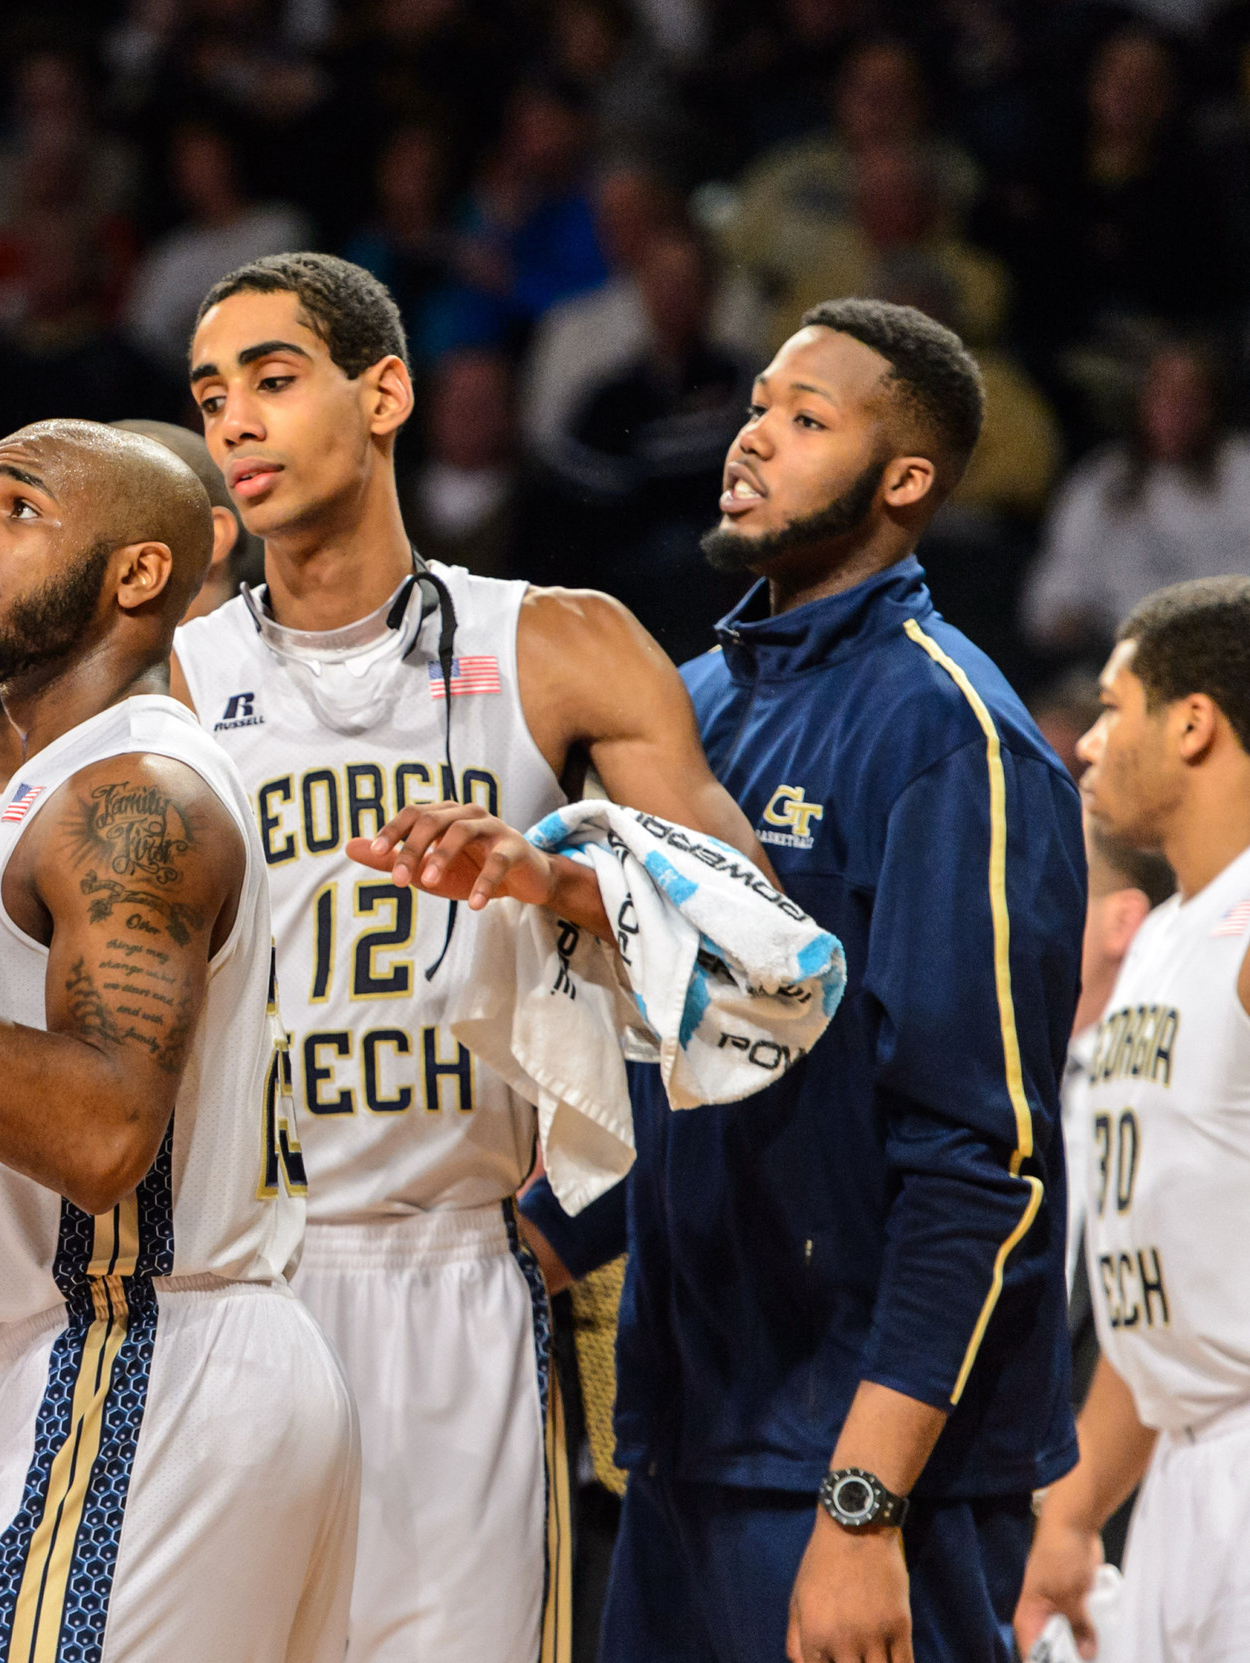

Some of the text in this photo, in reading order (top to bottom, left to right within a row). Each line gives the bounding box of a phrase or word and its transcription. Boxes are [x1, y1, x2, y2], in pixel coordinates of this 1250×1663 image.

[213, 715, 266, 733] RUSSELL
[308, 878, 418, 1004] 12
[284, 1024, 477, 1118] ECH
[1100, 1245, 1170, 1330] ECH
